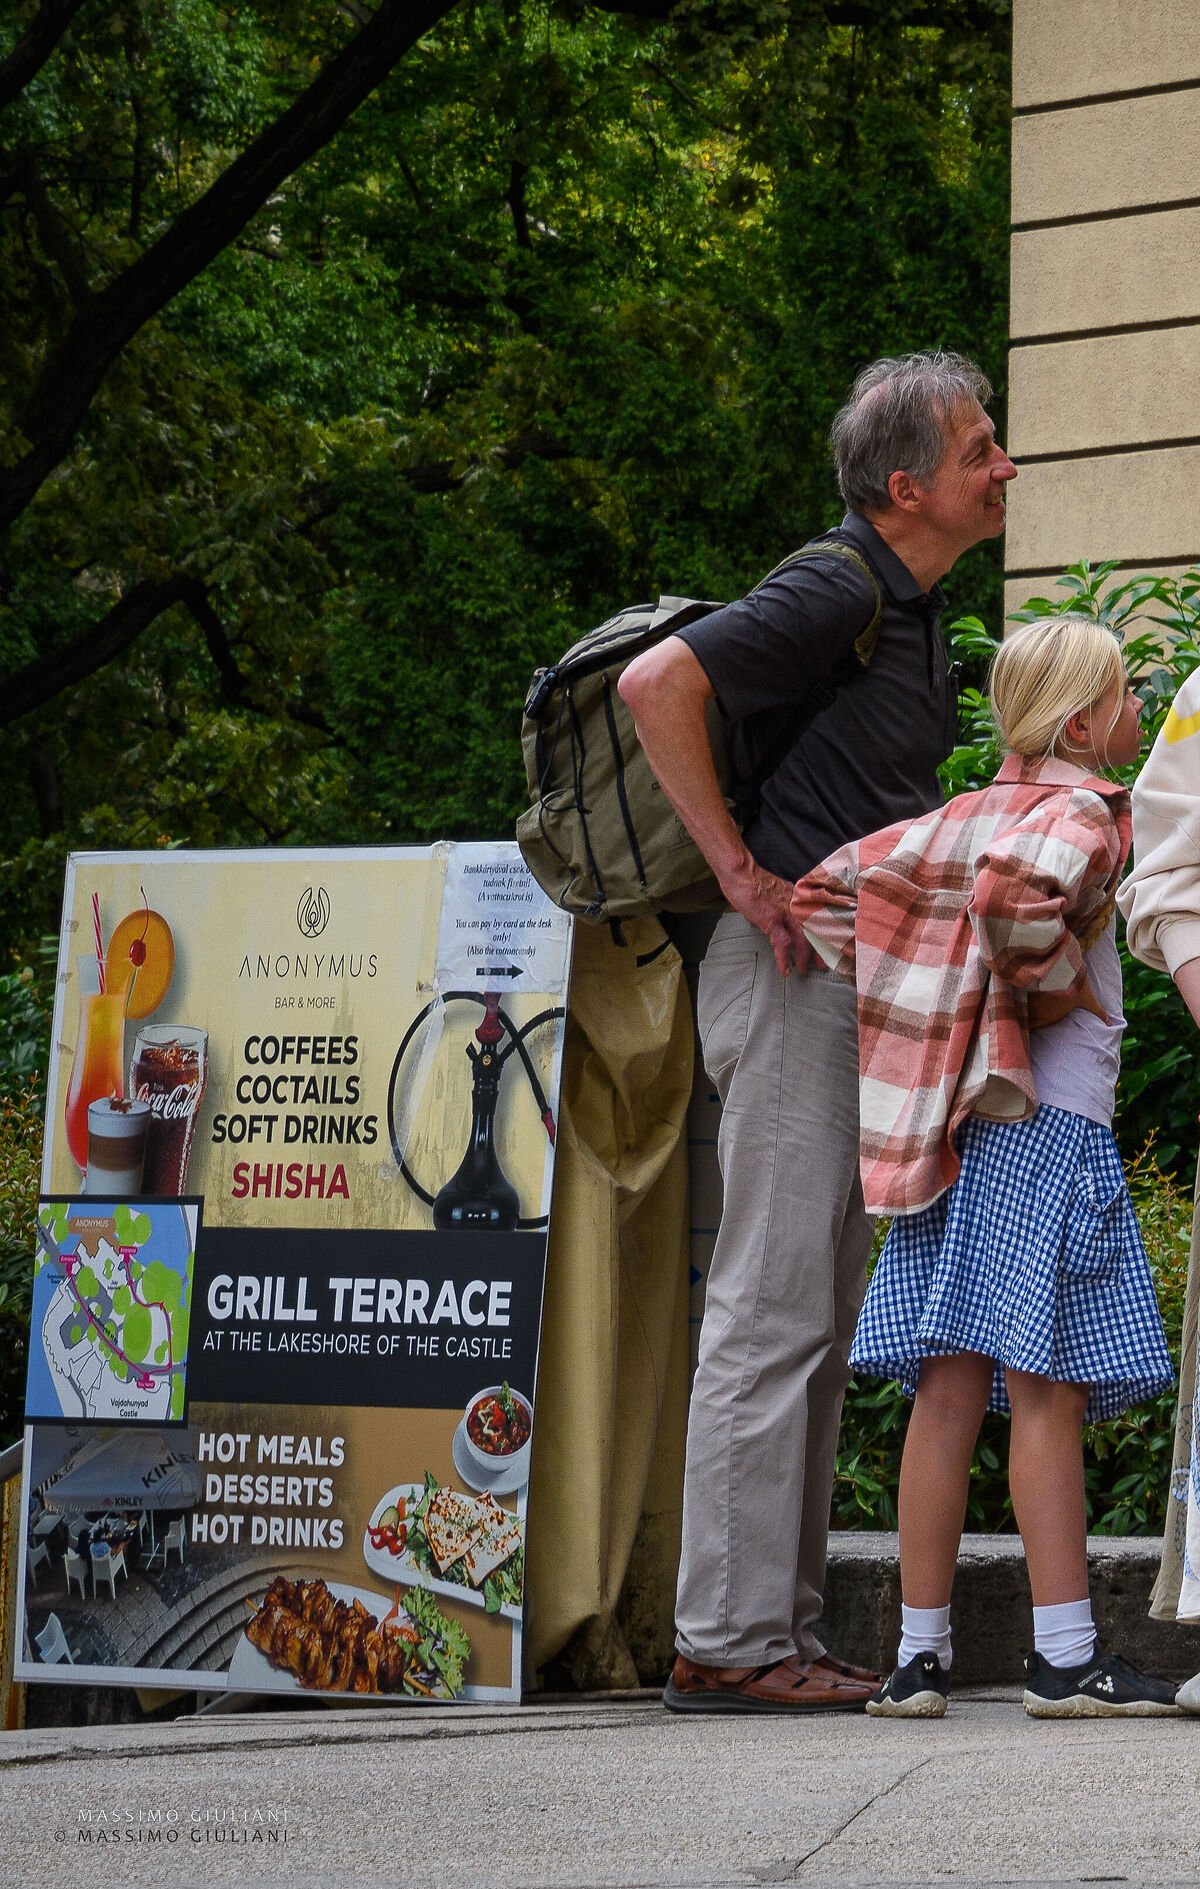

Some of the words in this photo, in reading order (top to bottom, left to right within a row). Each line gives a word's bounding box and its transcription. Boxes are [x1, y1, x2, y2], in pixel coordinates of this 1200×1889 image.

[456, 919, 467, 928] You
[468, 920, 479, 928] can
[480, 920, 492, 930] pay
[493, 919, 502, 931] by
[503, 919, 519, 928] card
[519, 919, 526, 928] at
[527, 919, 536, 928] the
[537, 919, 553, 928] desk
[492, 933, 512, 944] only!
[467, 946, 484, 957] (Also
[484, 946, 494, 955] the
[238, 954, 378, 979] ANONYMUS
[274, 996, 296, 1009] BAR
[297, 996, 305, 1009] &
[306, 996, 336, 1009] MORE
[244, 1035, 359, 1065] COFFEES
[235, 1074, 361, 1105] COCTAILS
[211, 1113, 279, 1145] SOFT
[283, 1114, 378, 1145] DRINKS
[232, 1162, 350, 1200] SHISHA
[75, 1218, 110, 1229] ANONYMUS
[207, 1275, 318, 1321] GRILL
[328, 1278, 512, 1327] TERRACE
[203, 1330, 225, 1351] AT
[230, 1331, 262, 1352] THE
[267, 1332, 371, 1355] LAKESHORE
[377, 1335, 401, 1355] OF
[406, 1336, 440, 1357] THE
[445, 1337, 512, 1359] CASTLE
[119, 1408, 138, 1418] Castle
[198, 1432, 251, 1463] HOT
[257, 1434, 345, 1467] MEALS
[115, 1497, 144, 1507] KINLEY
[205, 1473, 334, 1508] DESSERTS
[191, 1513, 245, 1544] HOT
[250, 1515, 344, 1549] DRINKS
